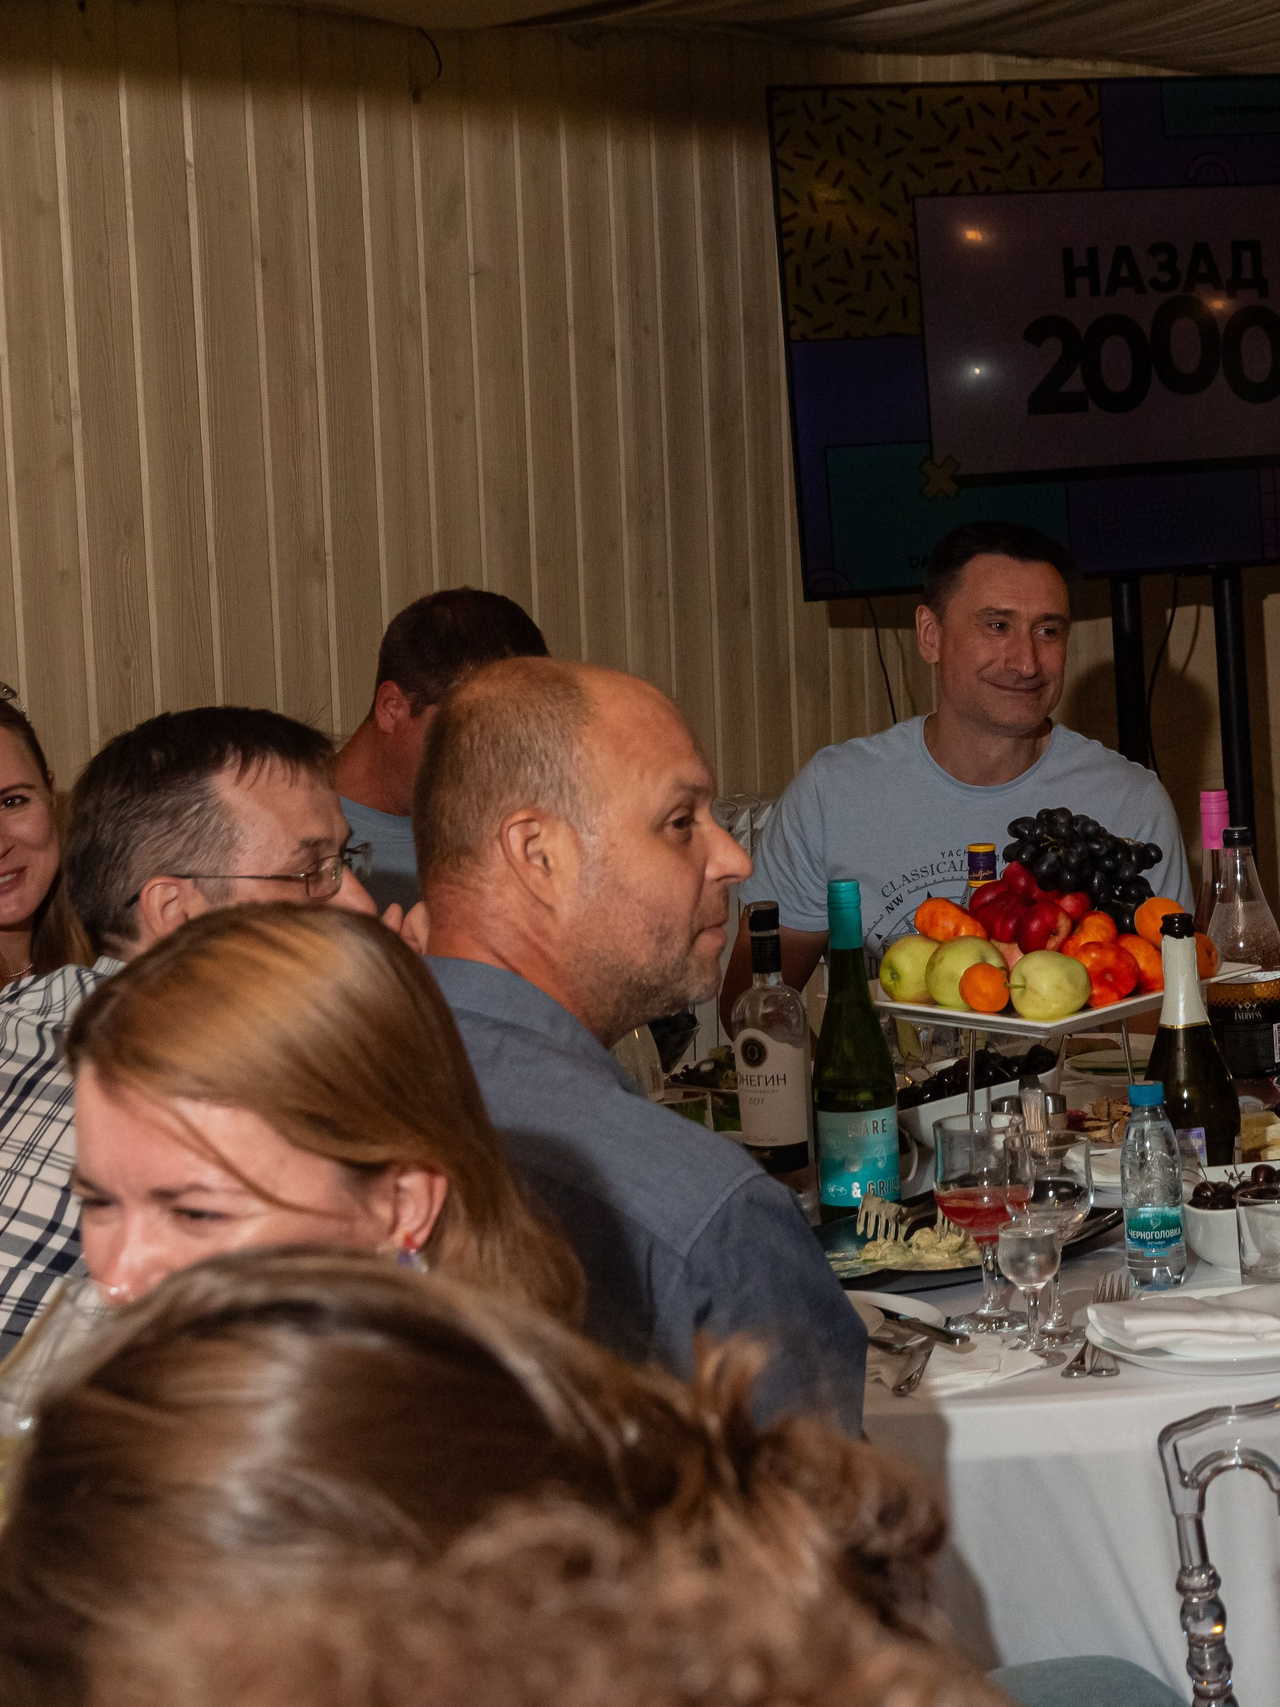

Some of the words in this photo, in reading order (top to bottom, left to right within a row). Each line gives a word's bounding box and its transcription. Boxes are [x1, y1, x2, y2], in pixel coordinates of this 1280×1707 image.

[1062, 240, 1269, 298] НАЗАД
[881, 859, 970, 899] CLASSICAL
[885, 893, 904, 914] NW
[1128, 1226, 1181, 1240] ЧЕРНОГОЛОВКА
